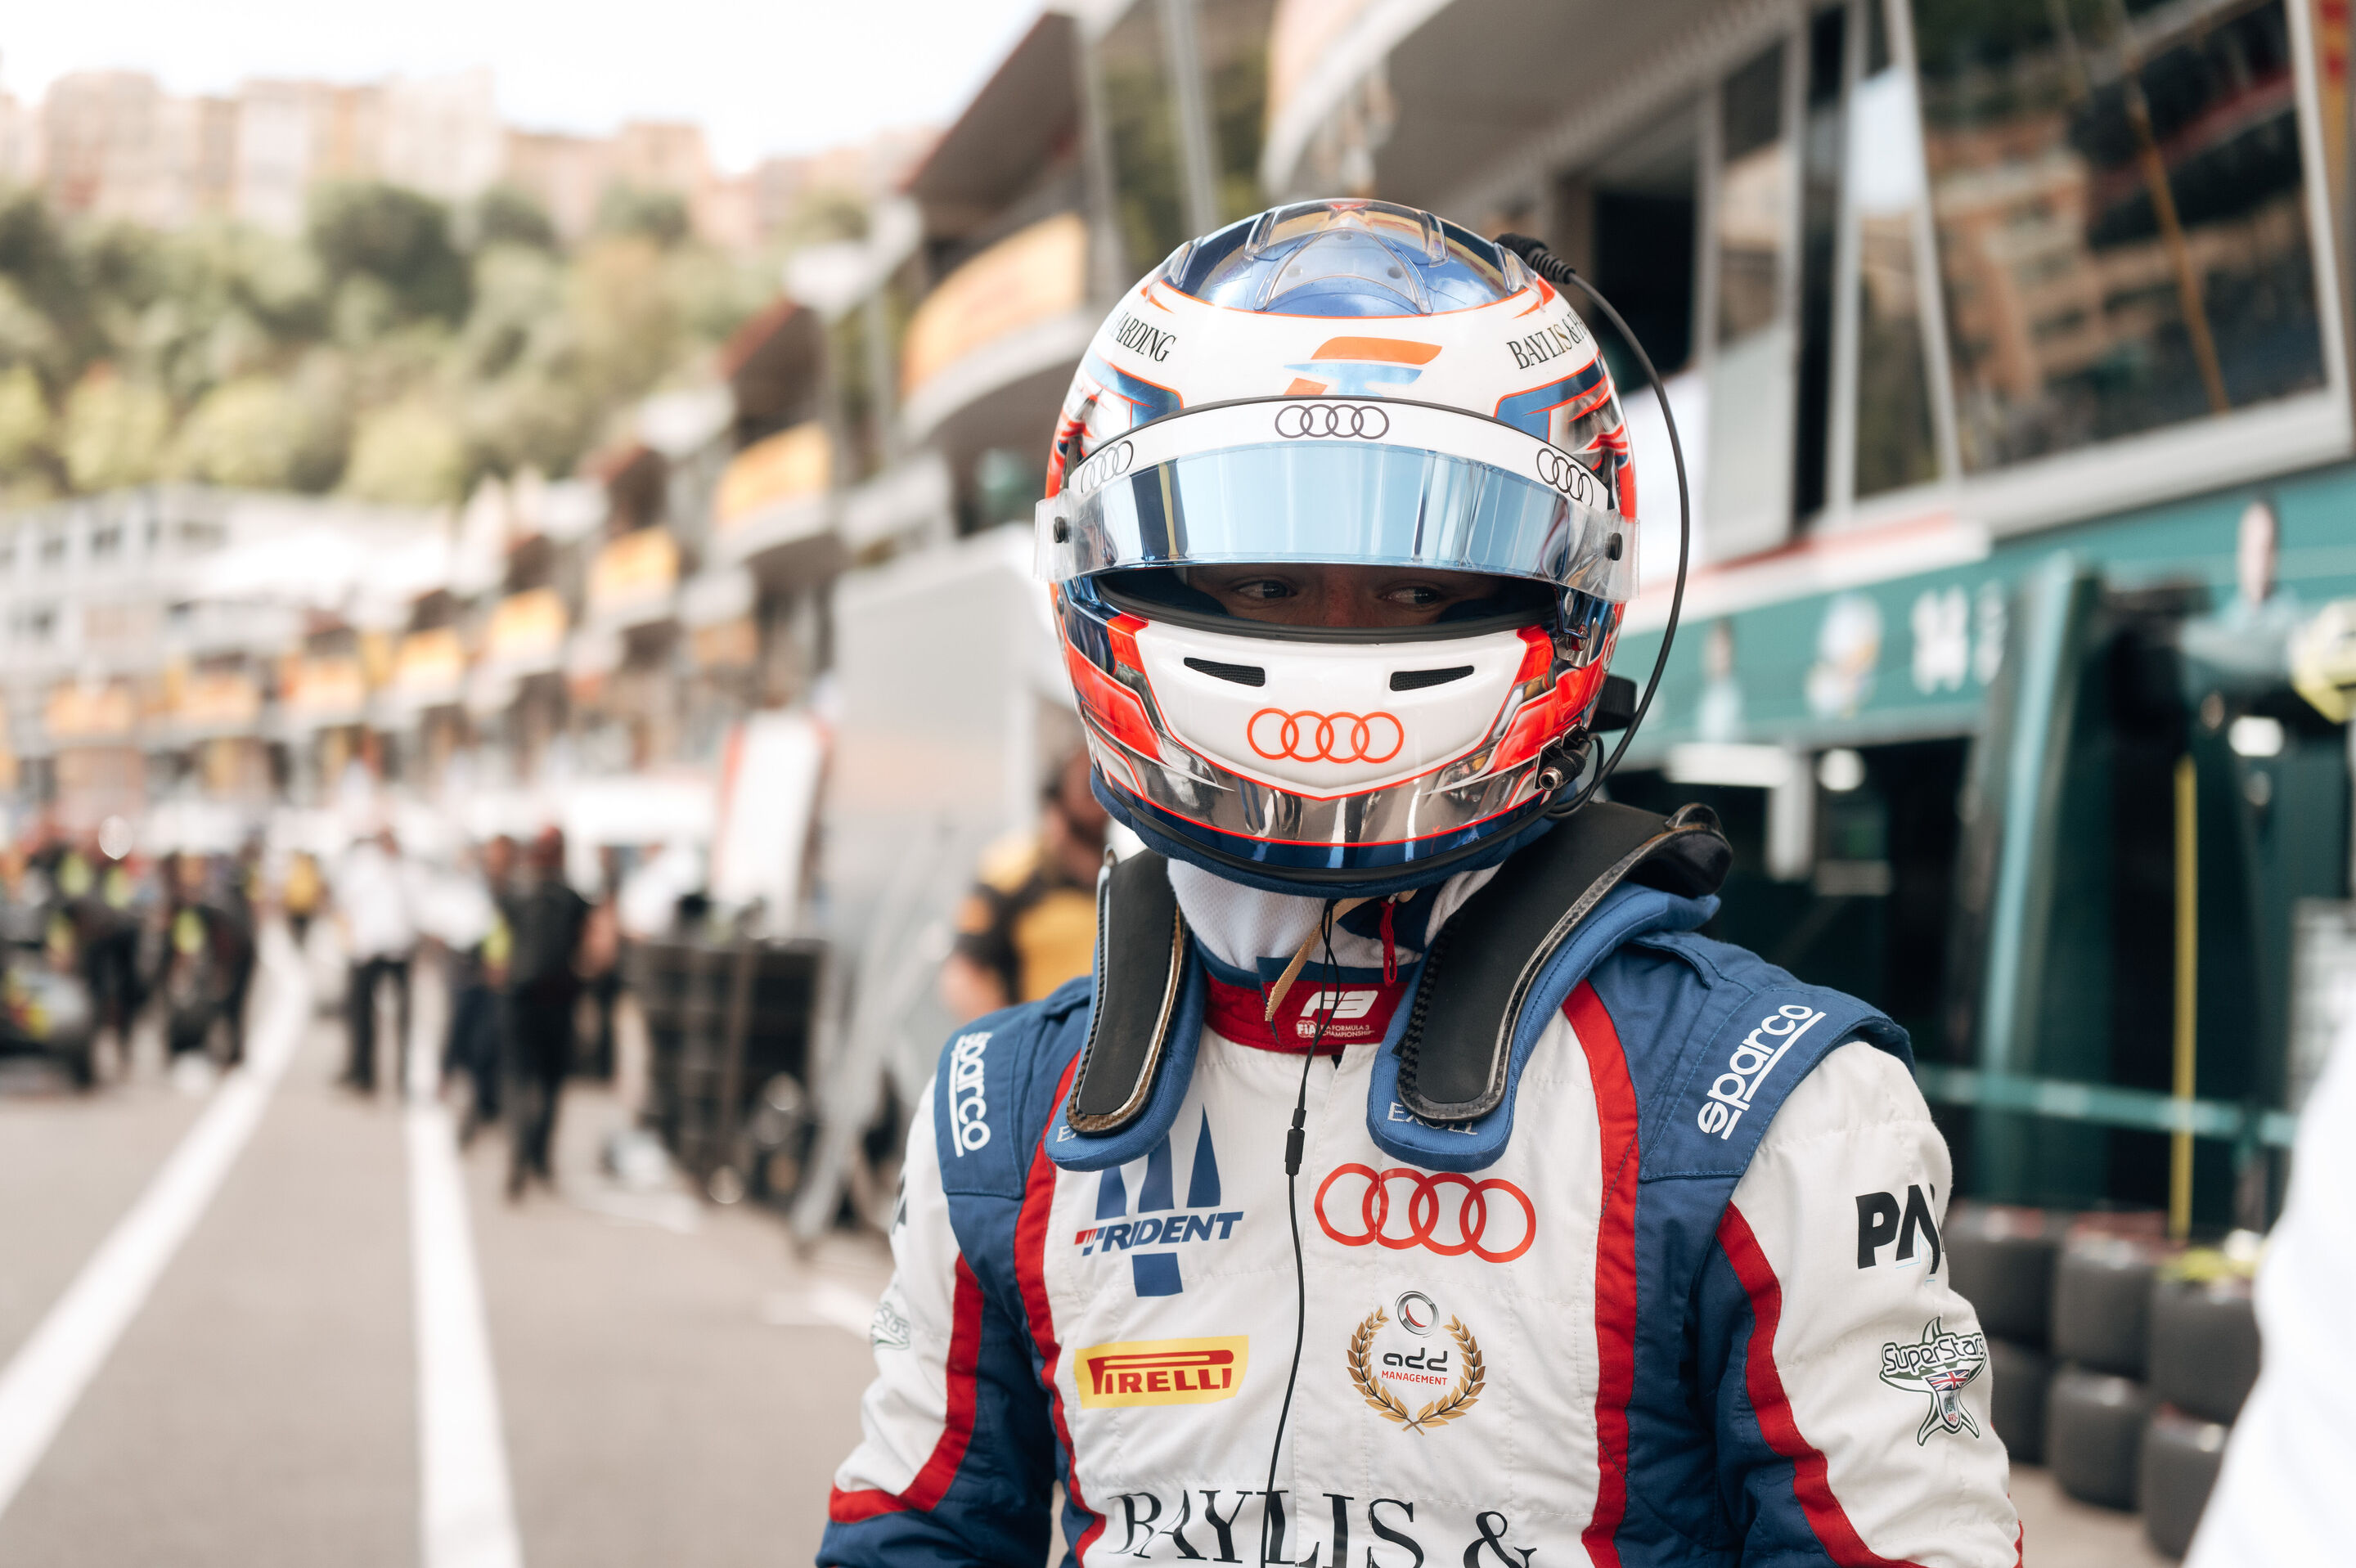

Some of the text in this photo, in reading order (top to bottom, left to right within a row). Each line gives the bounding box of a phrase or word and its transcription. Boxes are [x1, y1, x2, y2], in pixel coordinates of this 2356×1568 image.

[1506, 324, 1572, 370] BAYLIS
[1300, 990, 1379, 1019] F3
[1697, 1004, 1823, 1138] sparco
[1074, 1211, 1244, 1256] TRIDENT
[1086, 1350, 1234, 1395] PIRELLI
[1381, 1370, 1448, 1386] MANAGEMENT
[1383, 1347, 1448, 1373] add
[1106, 1489, 1537, 1568] BAYLIS &
